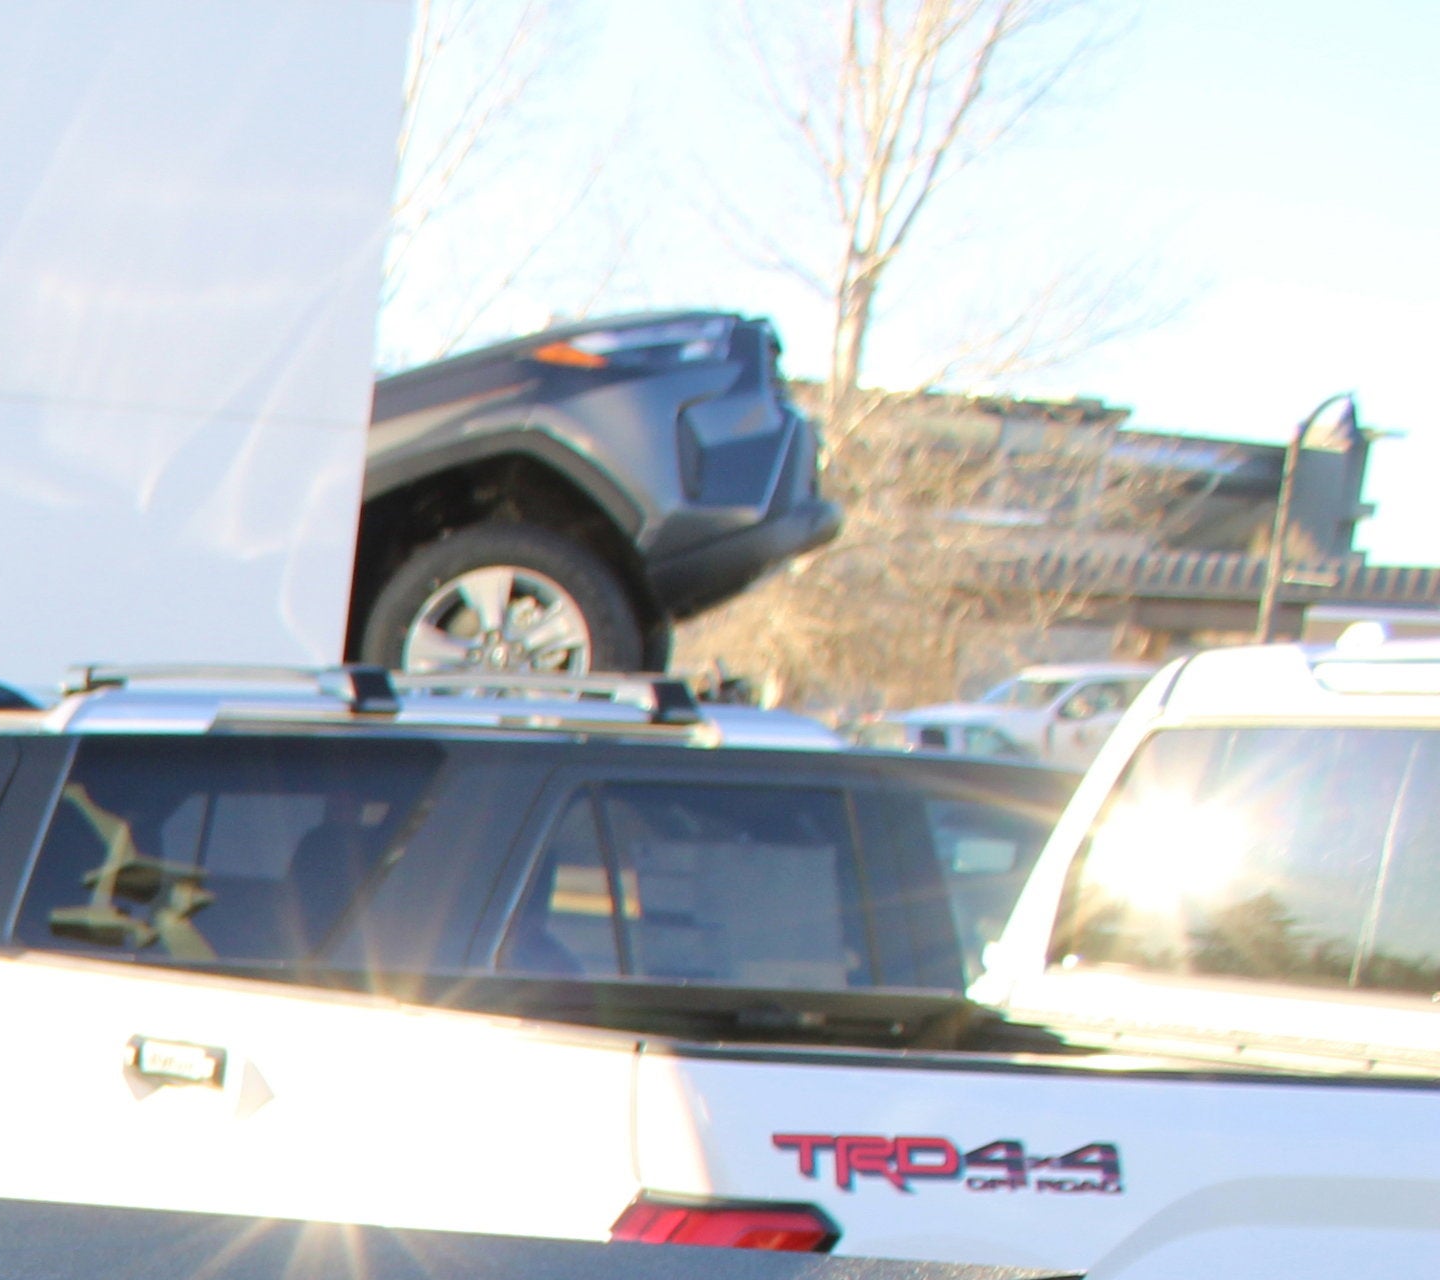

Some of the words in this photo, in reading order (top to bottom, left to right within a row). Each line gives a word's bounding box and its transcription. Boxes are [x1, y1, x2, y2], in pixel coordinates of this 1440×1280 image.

[772, 1133, 966, 1193] TRD
[967, 1177, 1026, 1192] OFF
[1036, 1180, 1122, 1195] ROAD
